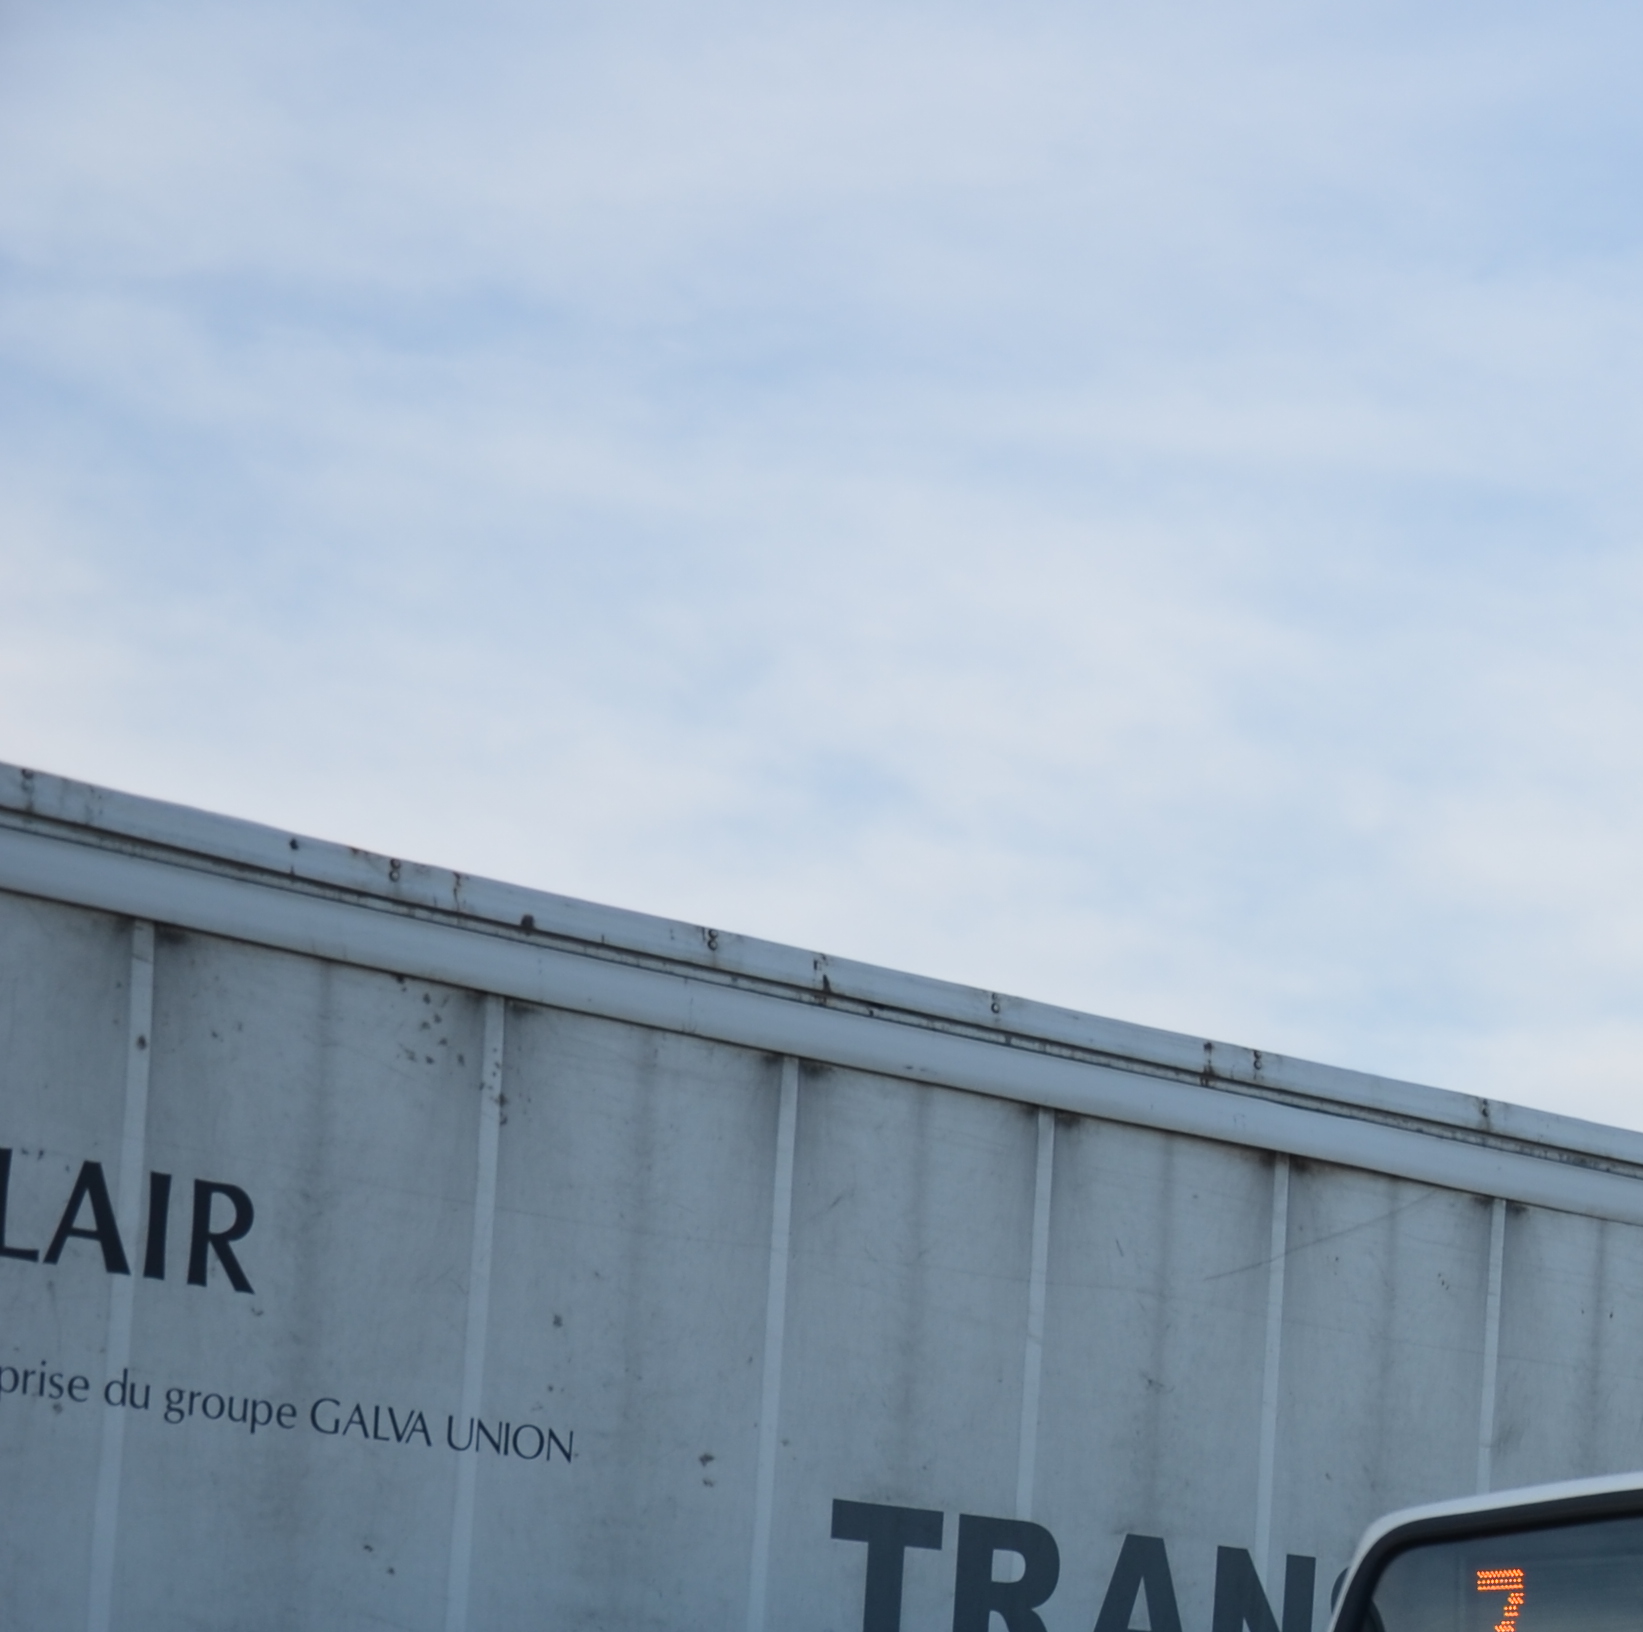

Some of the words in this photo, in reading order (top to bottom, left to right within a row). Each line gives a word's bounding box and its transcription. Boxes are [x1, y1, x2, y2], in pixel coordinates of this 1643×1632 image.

[103, 1368, 151, 1411] du
[164, 1386, 298, 1435] groupe
[310, 1397, 432, 1447] GALVA
[446, 1415, 575, 1464] UNION
